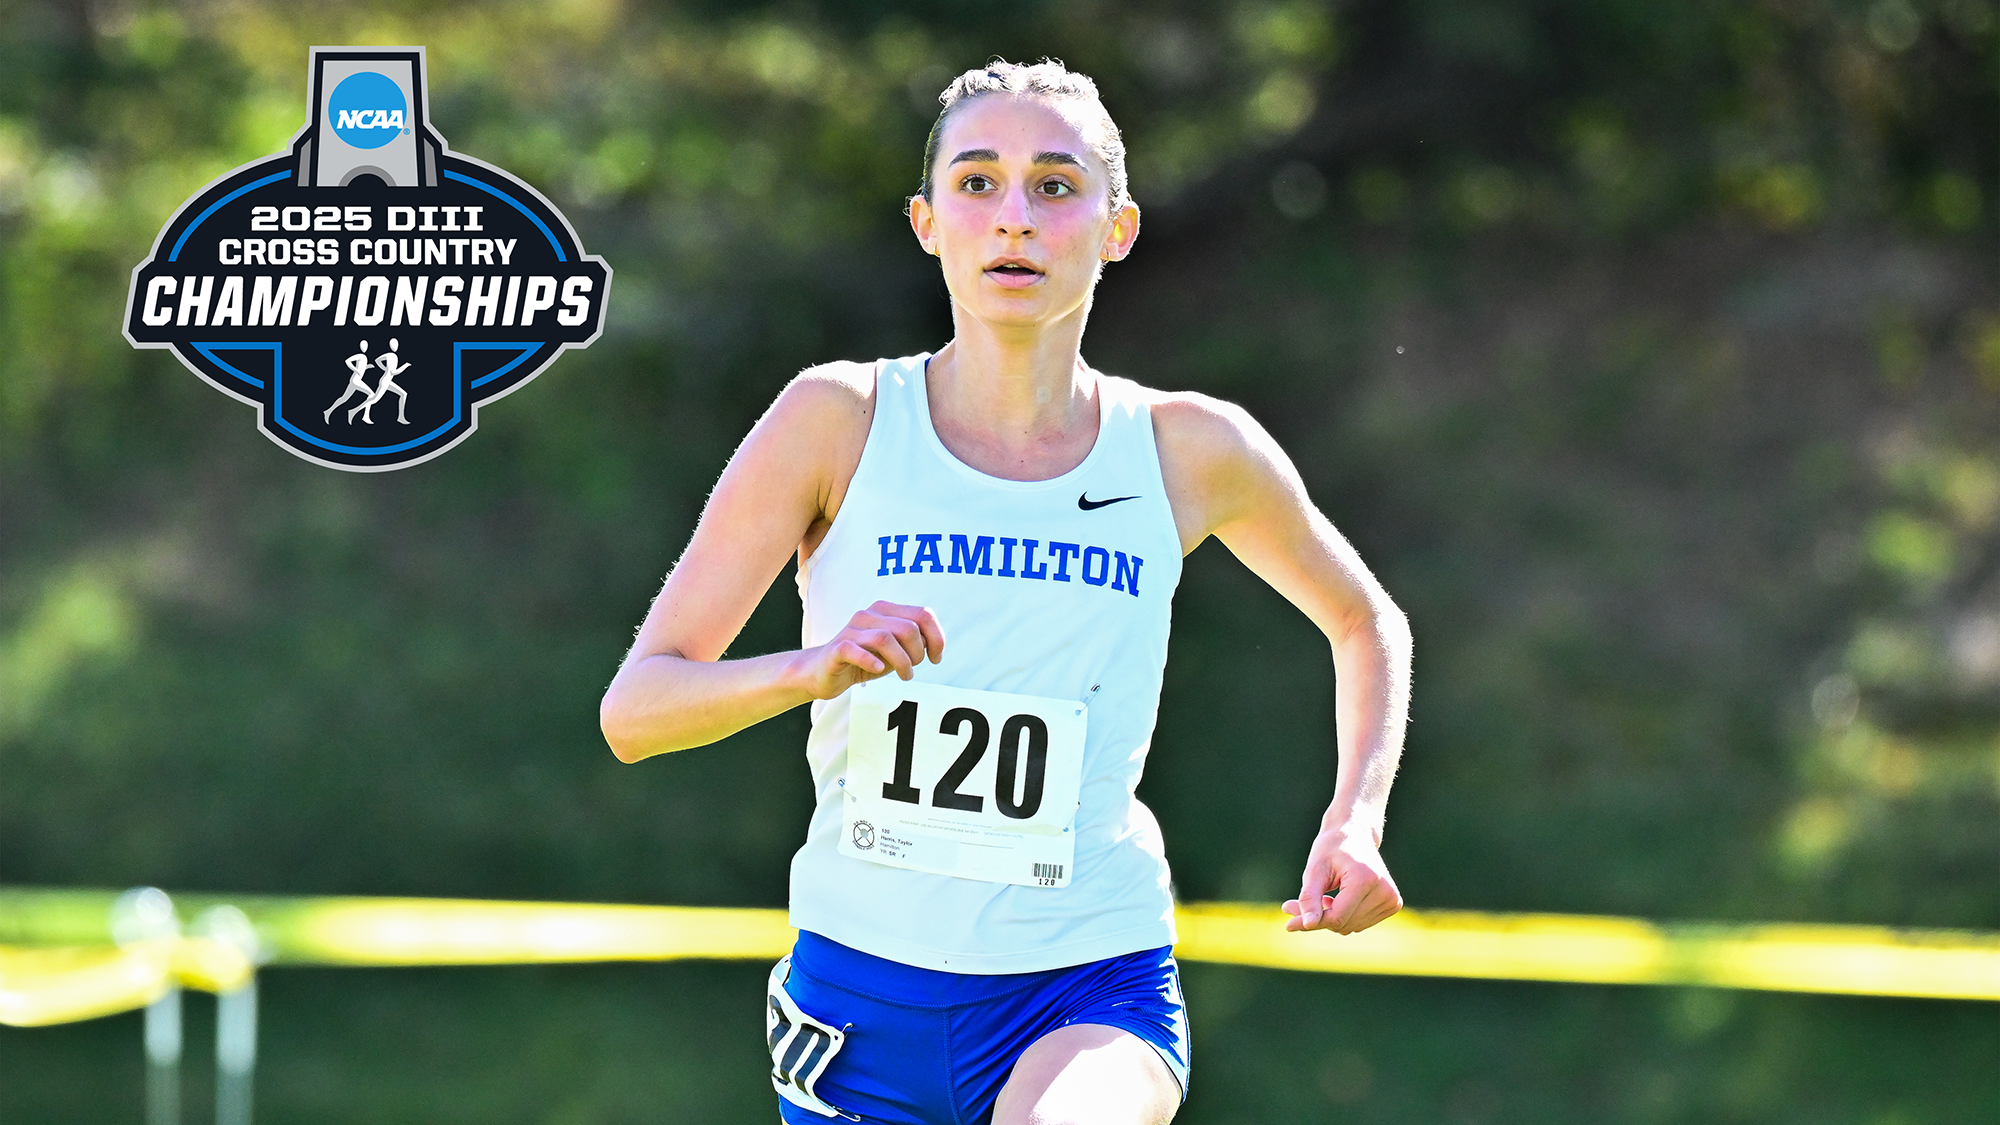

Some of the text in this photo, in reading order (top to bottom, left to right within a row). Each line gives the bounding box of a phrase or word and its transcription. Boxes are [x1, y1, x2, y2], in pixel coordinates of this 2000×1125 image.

[877, 533, 1144, 598] HAMILTON
[882, 699, 1049, 820] 120
[1038, 878, 1056, 887] 120
